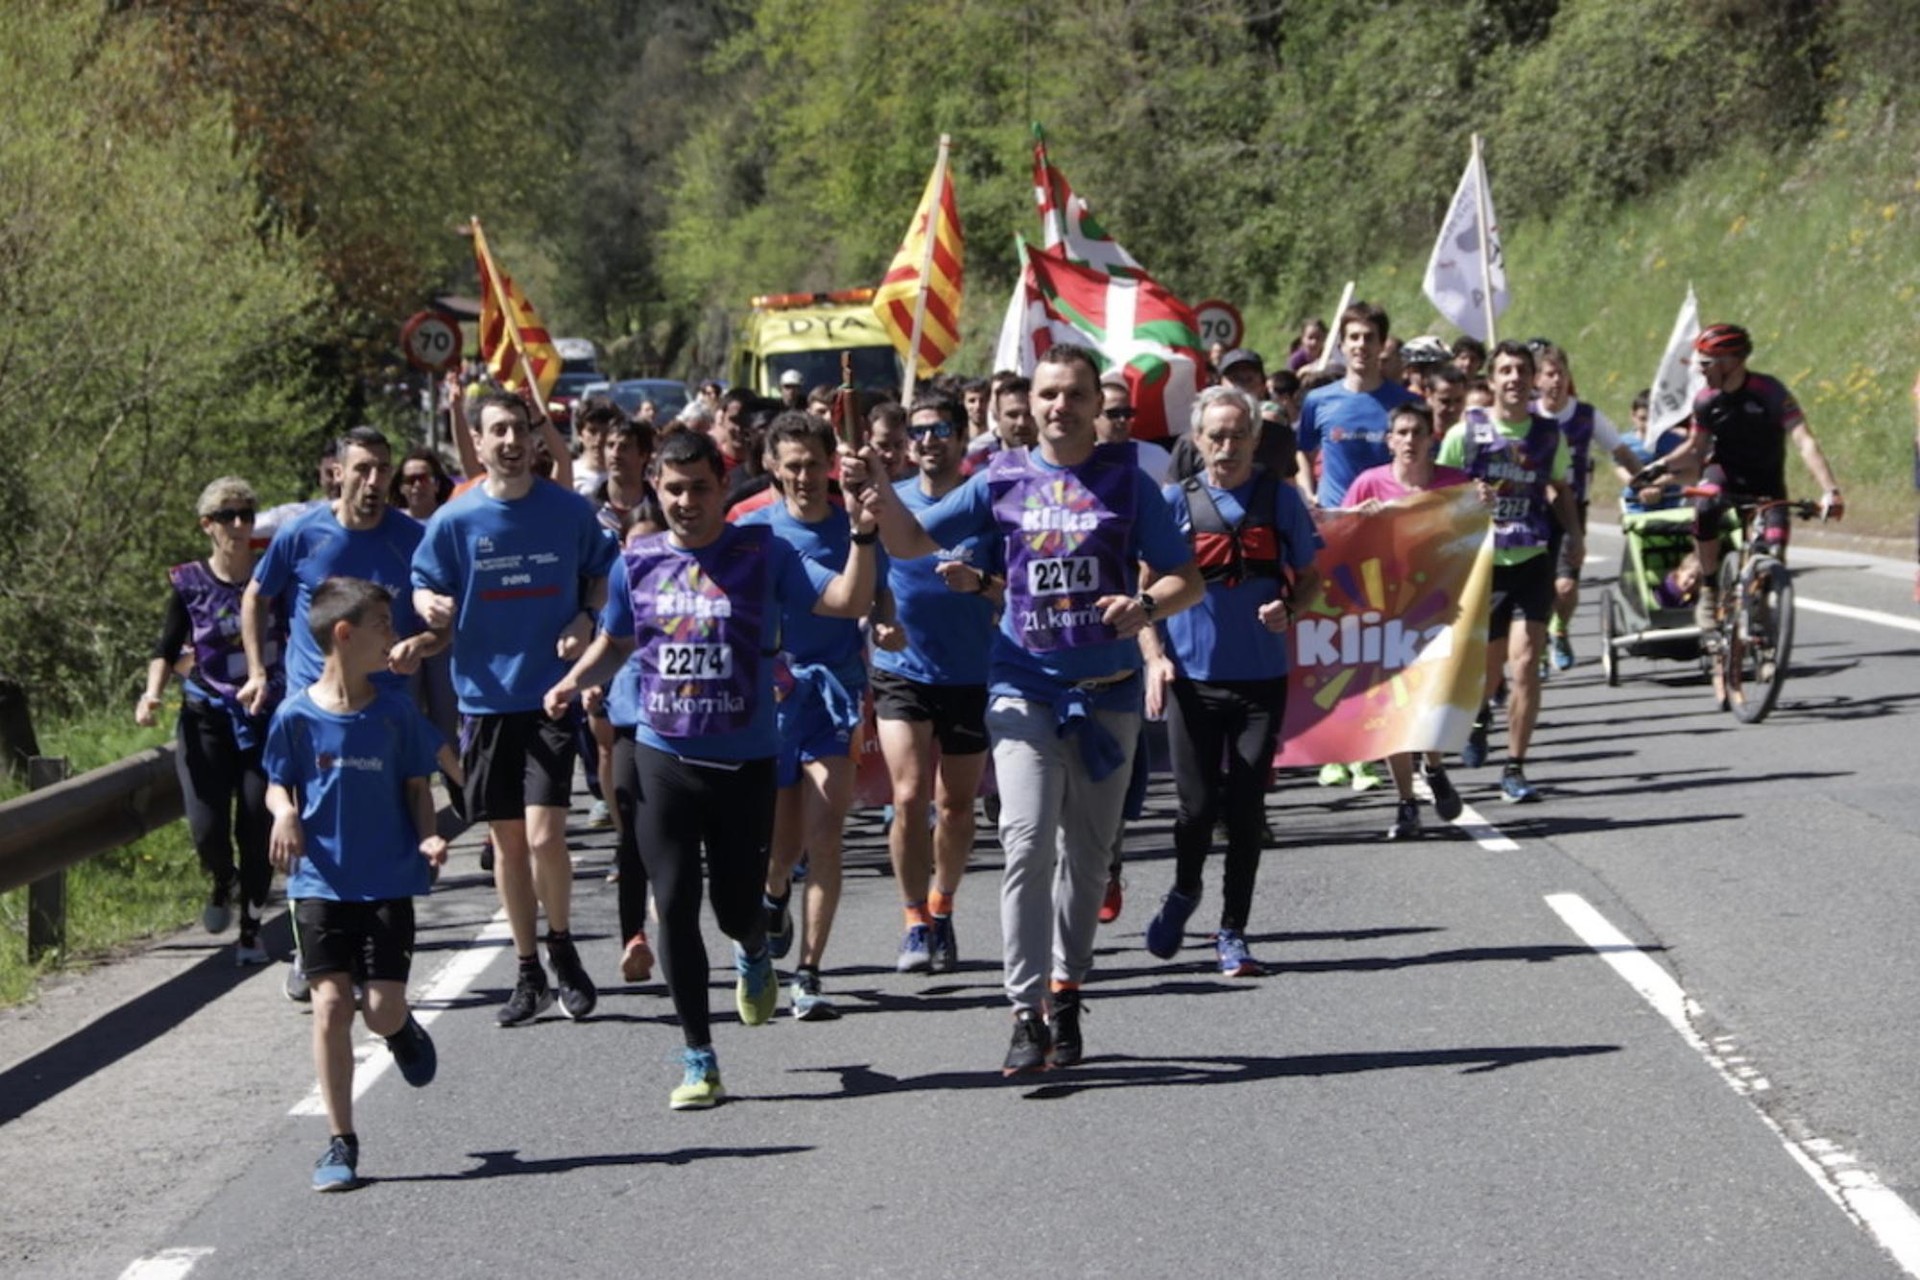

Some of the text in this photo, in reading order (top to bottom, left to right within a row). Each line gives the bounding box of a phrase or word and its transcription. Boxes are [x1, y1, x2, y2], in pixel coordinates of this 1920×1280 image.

[789, 316, 867, 339] DYA
[1201, 319, 1231, 339] 70
[419, 331, 450, 352] 70
[1022, 506, 1099, 532] Klika
[1034, 559, 1092, 591] 2274
[656, 591, 732, 618] Klika
[665, 648, 724, 675] 2274
[671, 690, 745, 715] korrika
